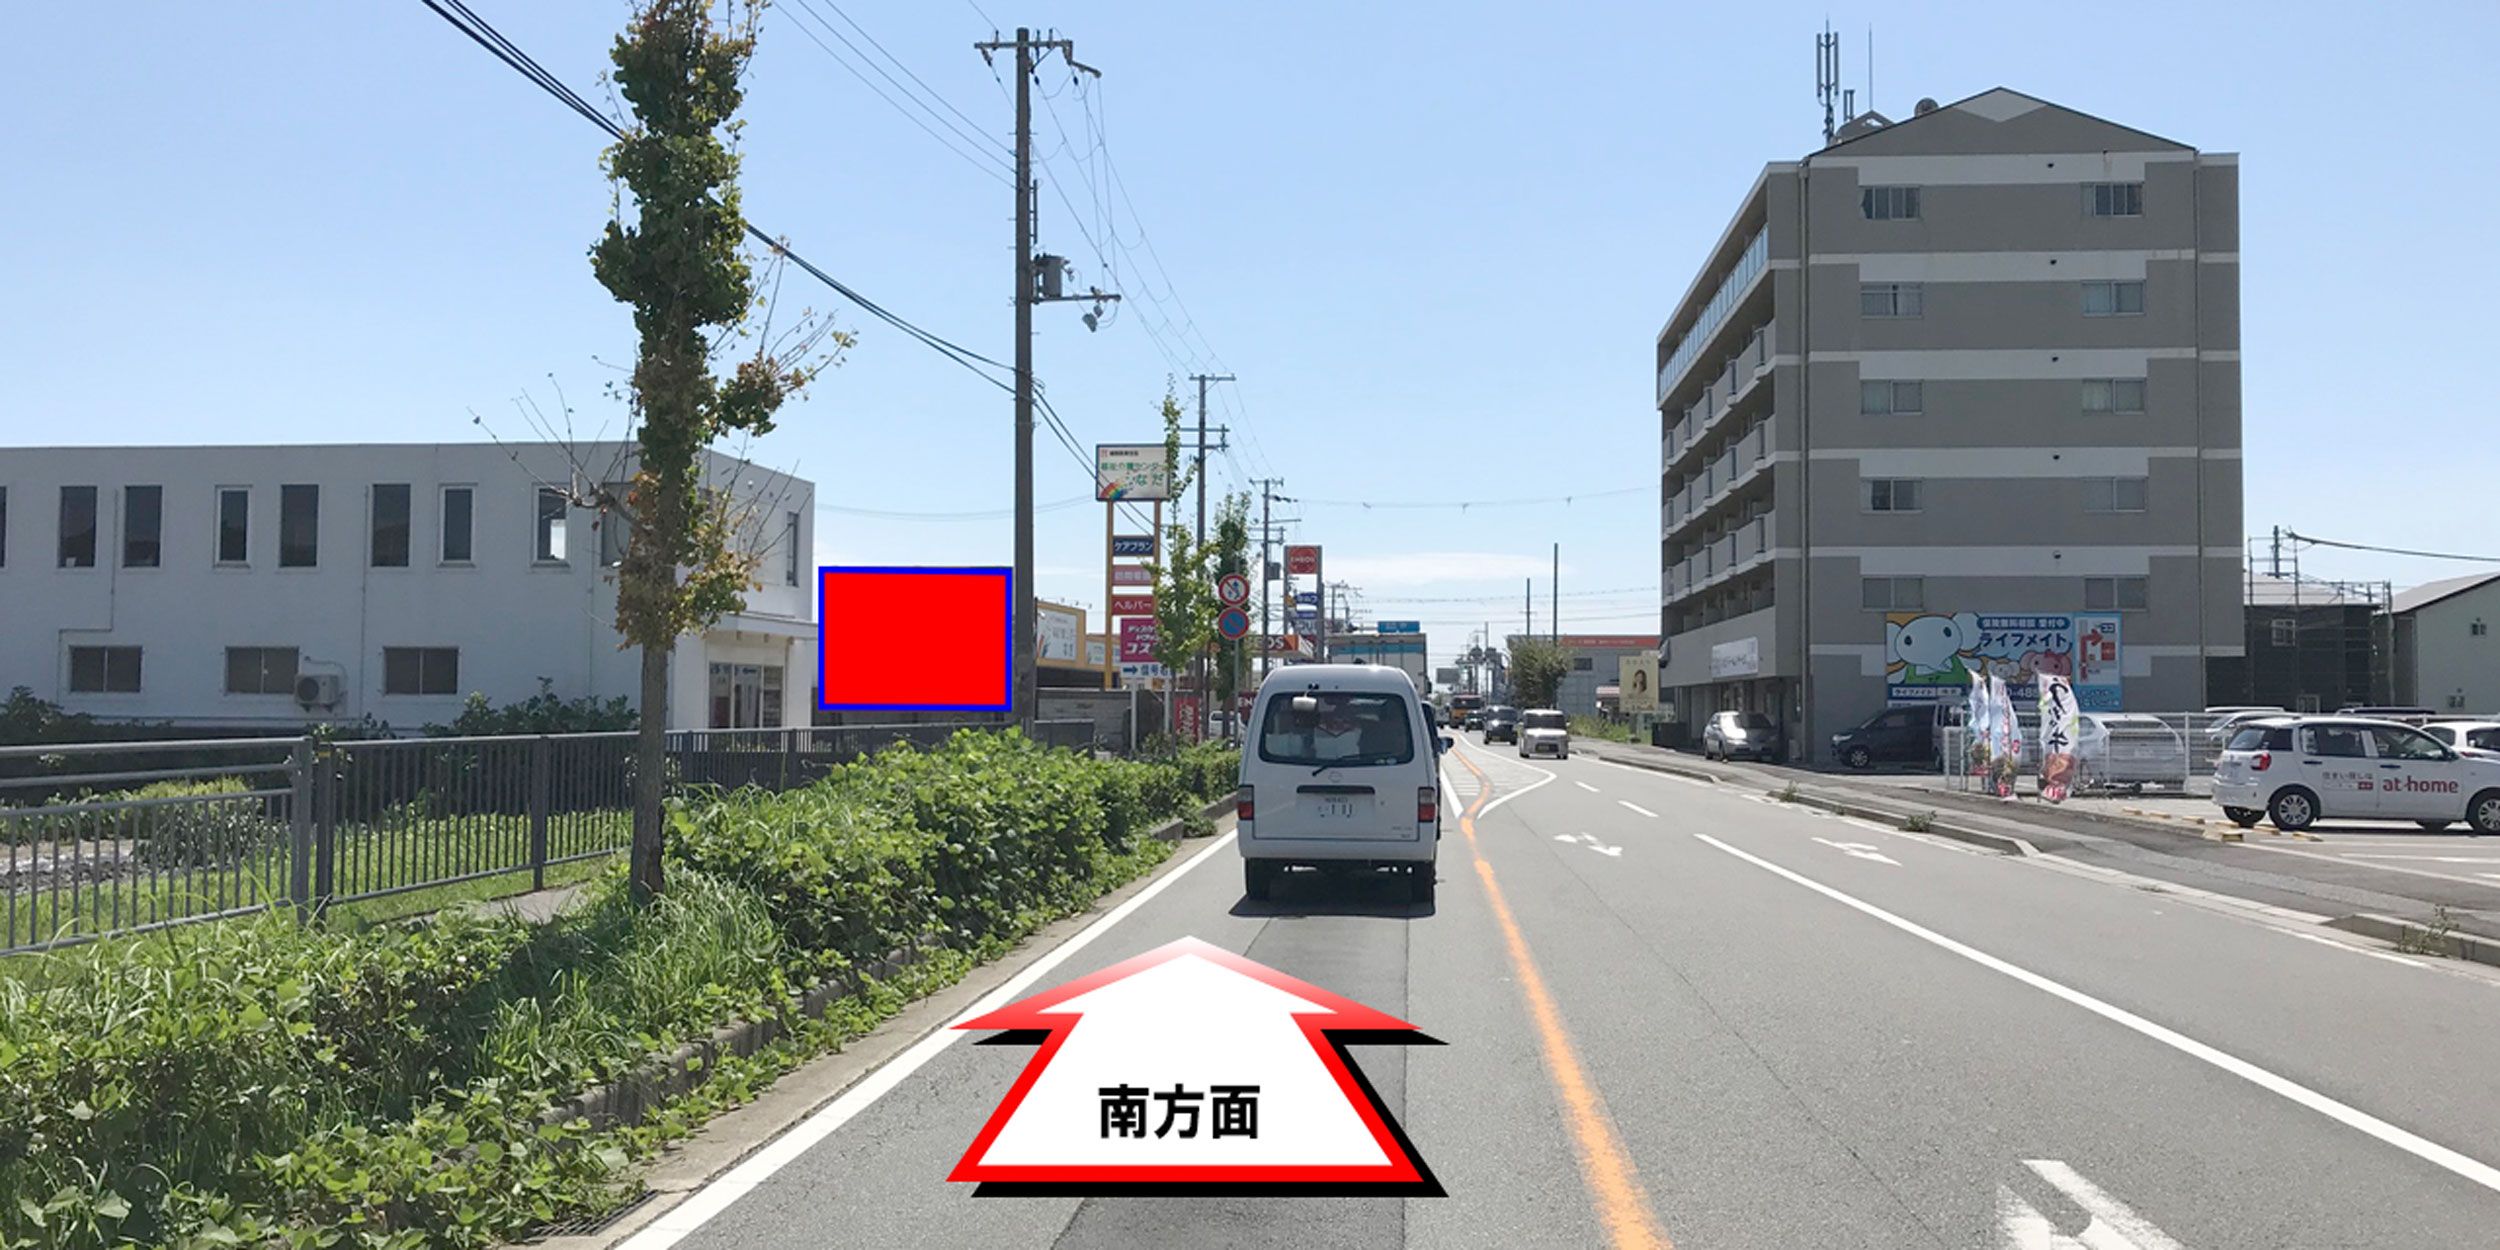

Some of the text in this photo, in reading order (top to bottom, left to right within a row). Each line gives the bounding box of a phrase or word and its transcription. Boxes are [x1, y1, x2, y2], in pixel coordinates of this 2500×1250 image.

[1114, 541, 1153, 552] ケアプラン
[1114, 600, 1152, 610] ヘルパー
[1979, 632, 2066, 648] ライフメイト
[1125, 642, 1152, 655] コス
[1238, 697, 1253, 707] EN
